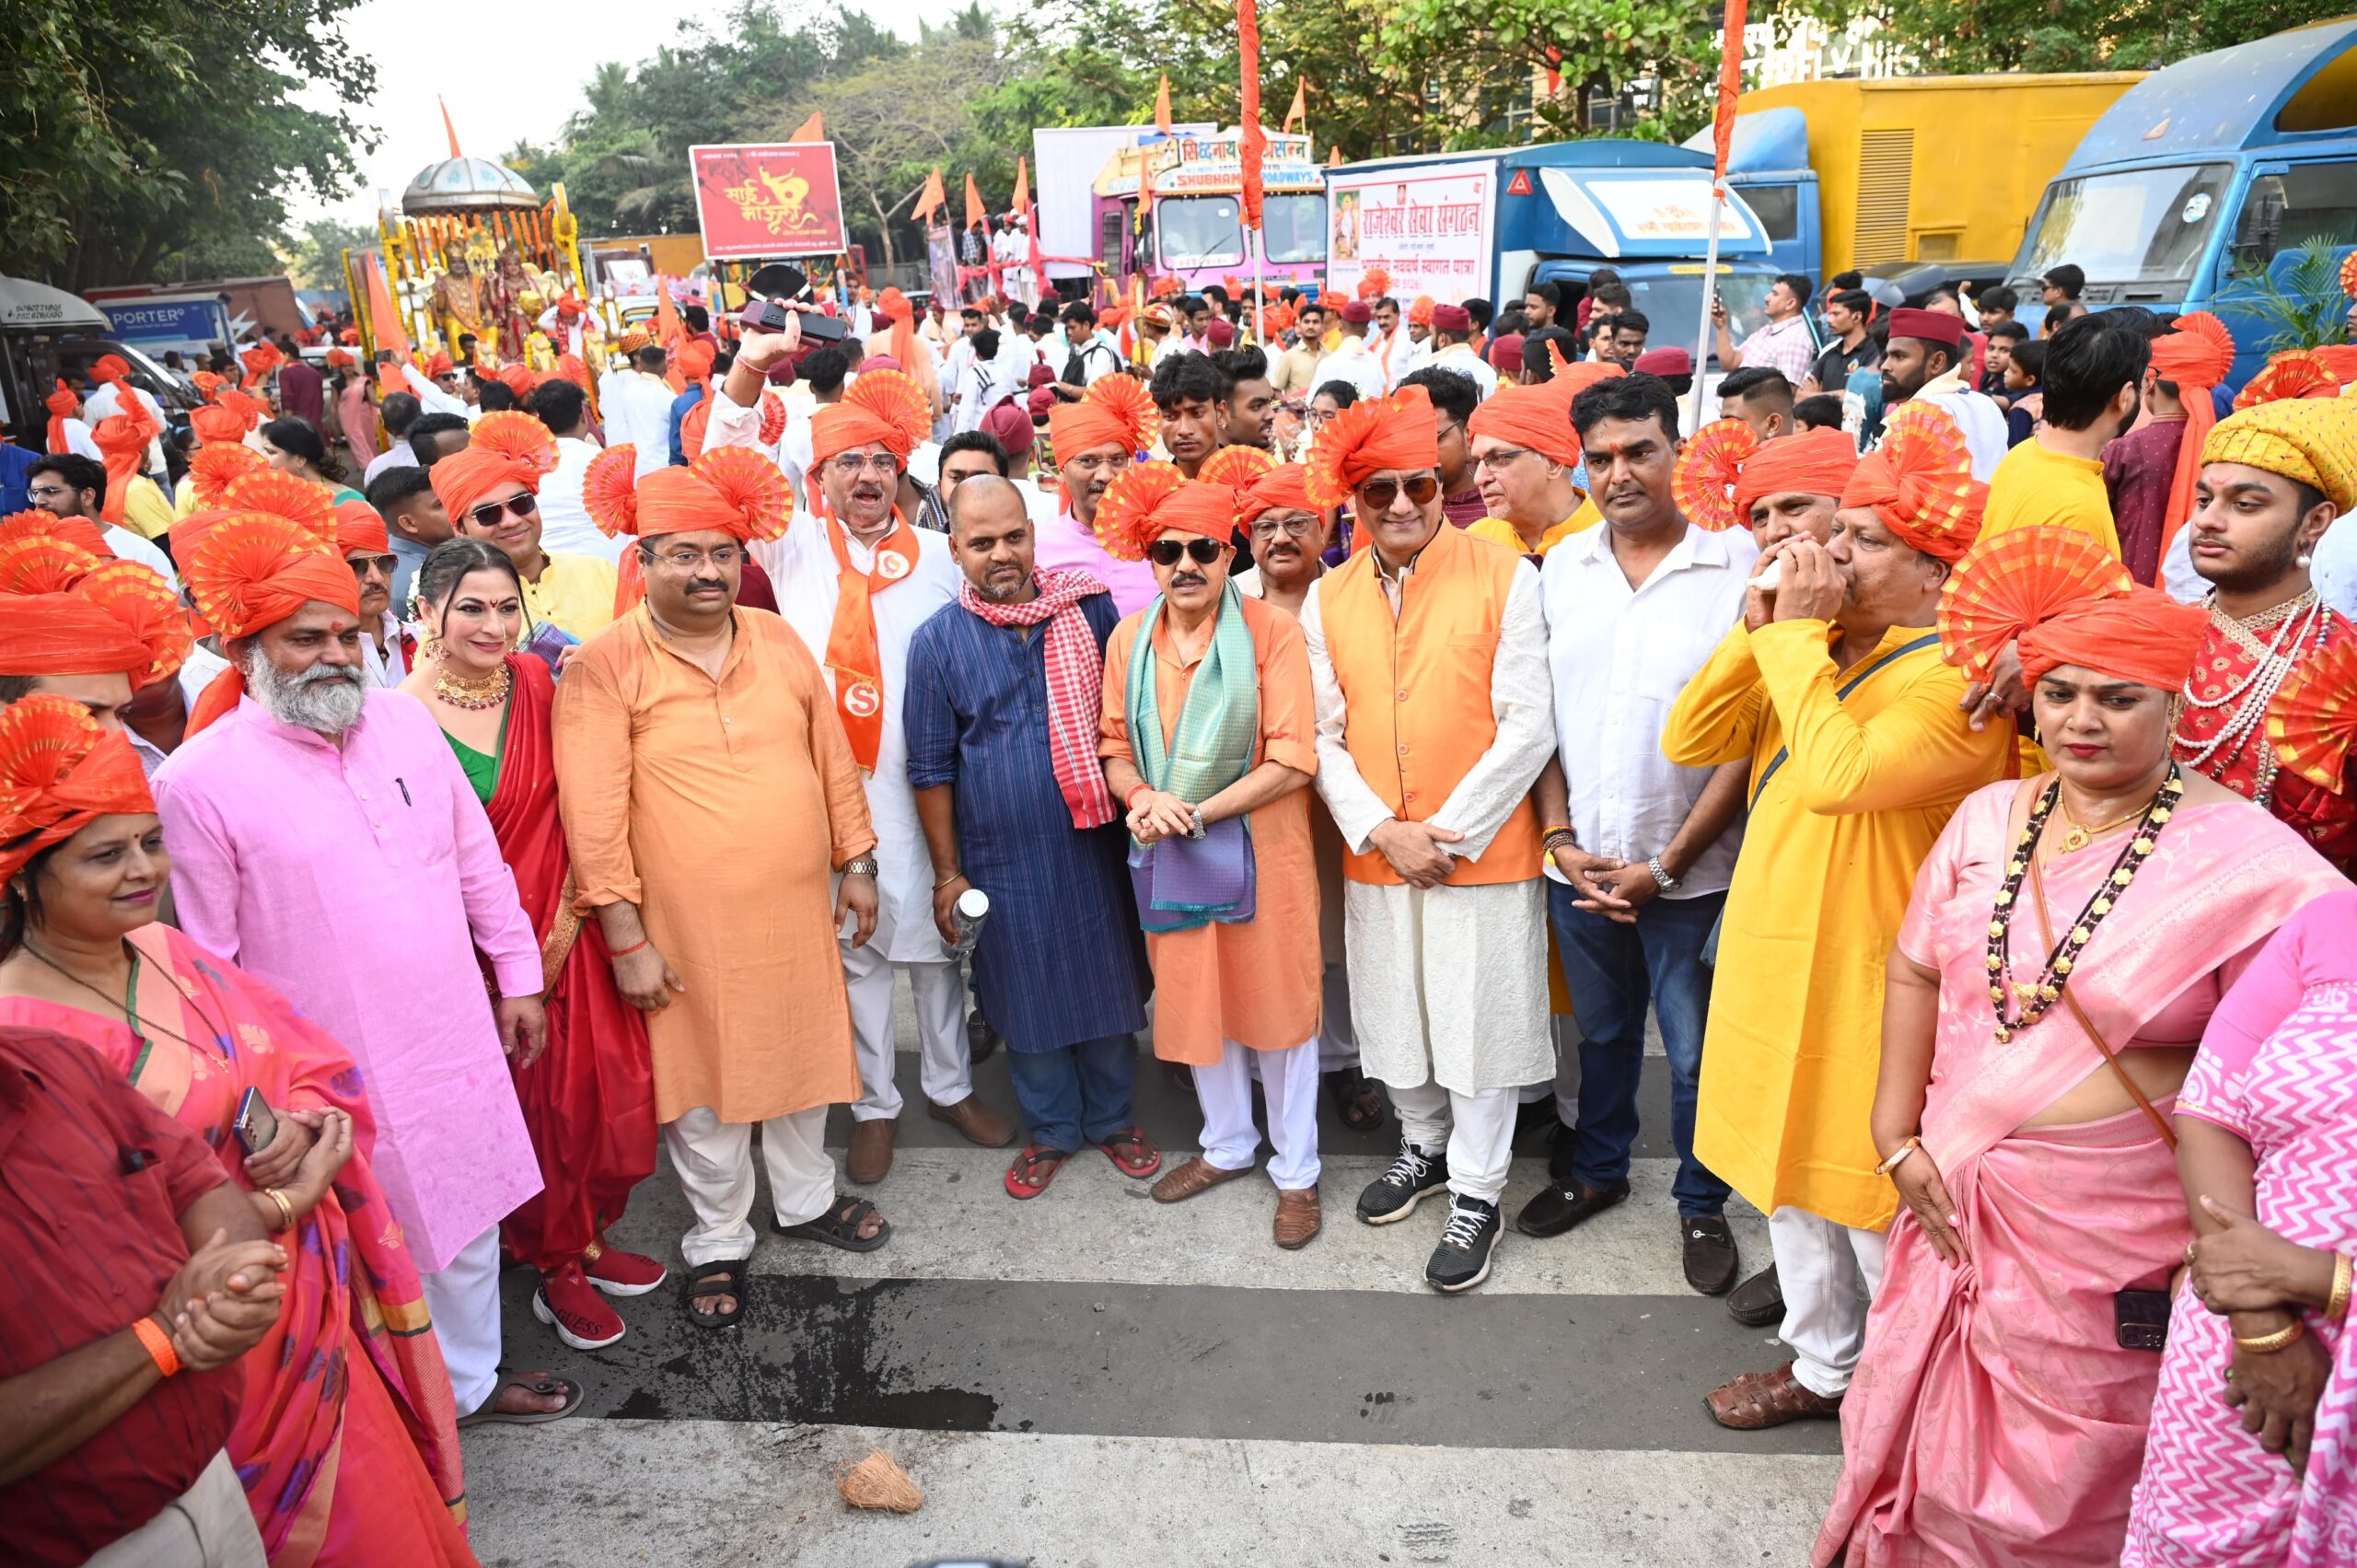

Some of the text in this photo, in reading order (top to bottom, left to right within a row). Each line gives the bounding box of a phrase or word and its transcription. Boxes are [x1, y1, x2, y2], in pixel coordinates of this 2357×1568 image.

[1177, 173, 1241, 186] SHUBHAM
[1364, 194, 1481, 235] राजेश्वर सेवा संगठन
[1422, 260, 1450, 274] स्वागत
[1453, 259, 1476, 275] यात्रा
[851, 685, 876, 714] S
[557, 1308, 602, 1336] GUESS
